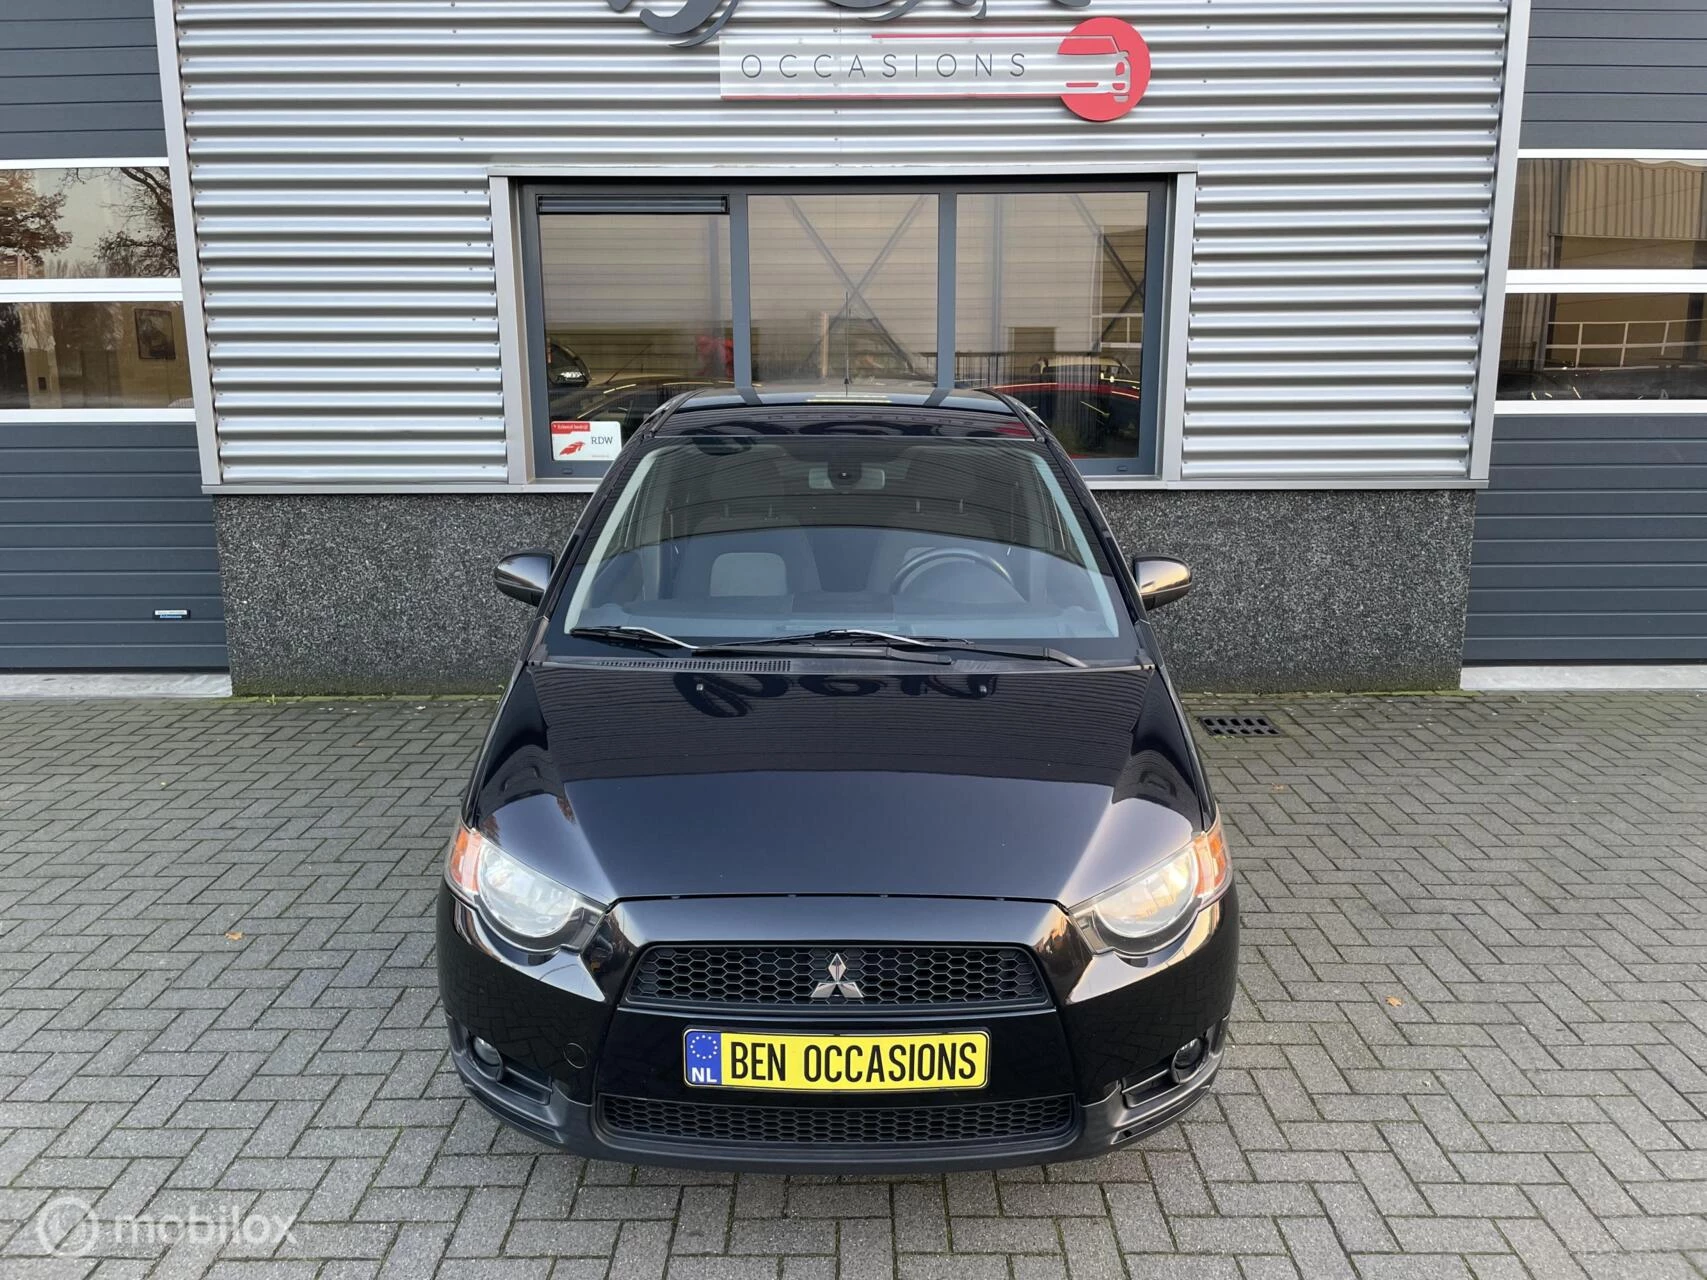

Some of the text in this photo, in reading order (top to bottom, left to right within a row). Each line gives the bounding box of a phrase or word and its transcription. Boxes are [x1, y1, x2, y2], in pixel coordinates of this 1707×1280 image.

[741, 53, 1026, 78] OCCASIONS
[591, 436, 613, 445] RDW
[730, 1041, 977, 1083] BEN OCCASIONS
[691, 1067, 717, 1083] NL
